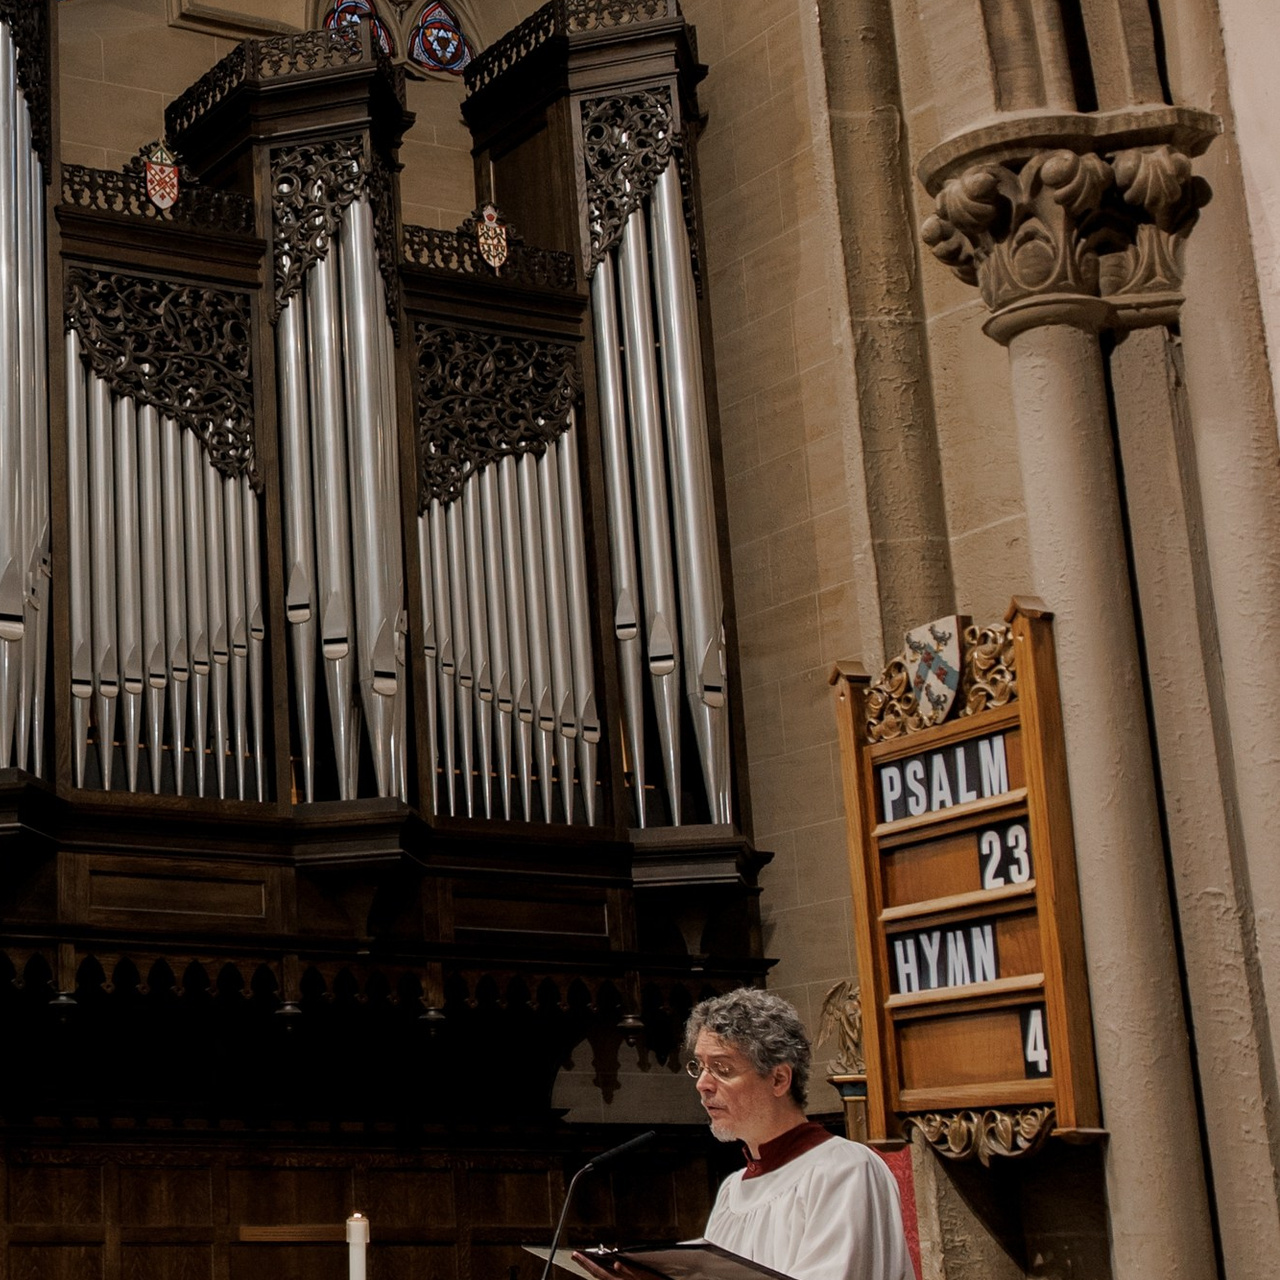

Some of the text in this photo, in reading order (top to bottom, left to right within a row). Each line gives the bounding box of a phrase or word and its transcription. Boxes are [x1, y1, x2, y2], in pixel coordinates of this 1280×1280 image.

[880, 735, 1009, 823] PSALM
[980, 824, 1032, 890] 23
[894, 925, 996, 994] HYMN
[1026, 1008, 1049, 1073] 4
